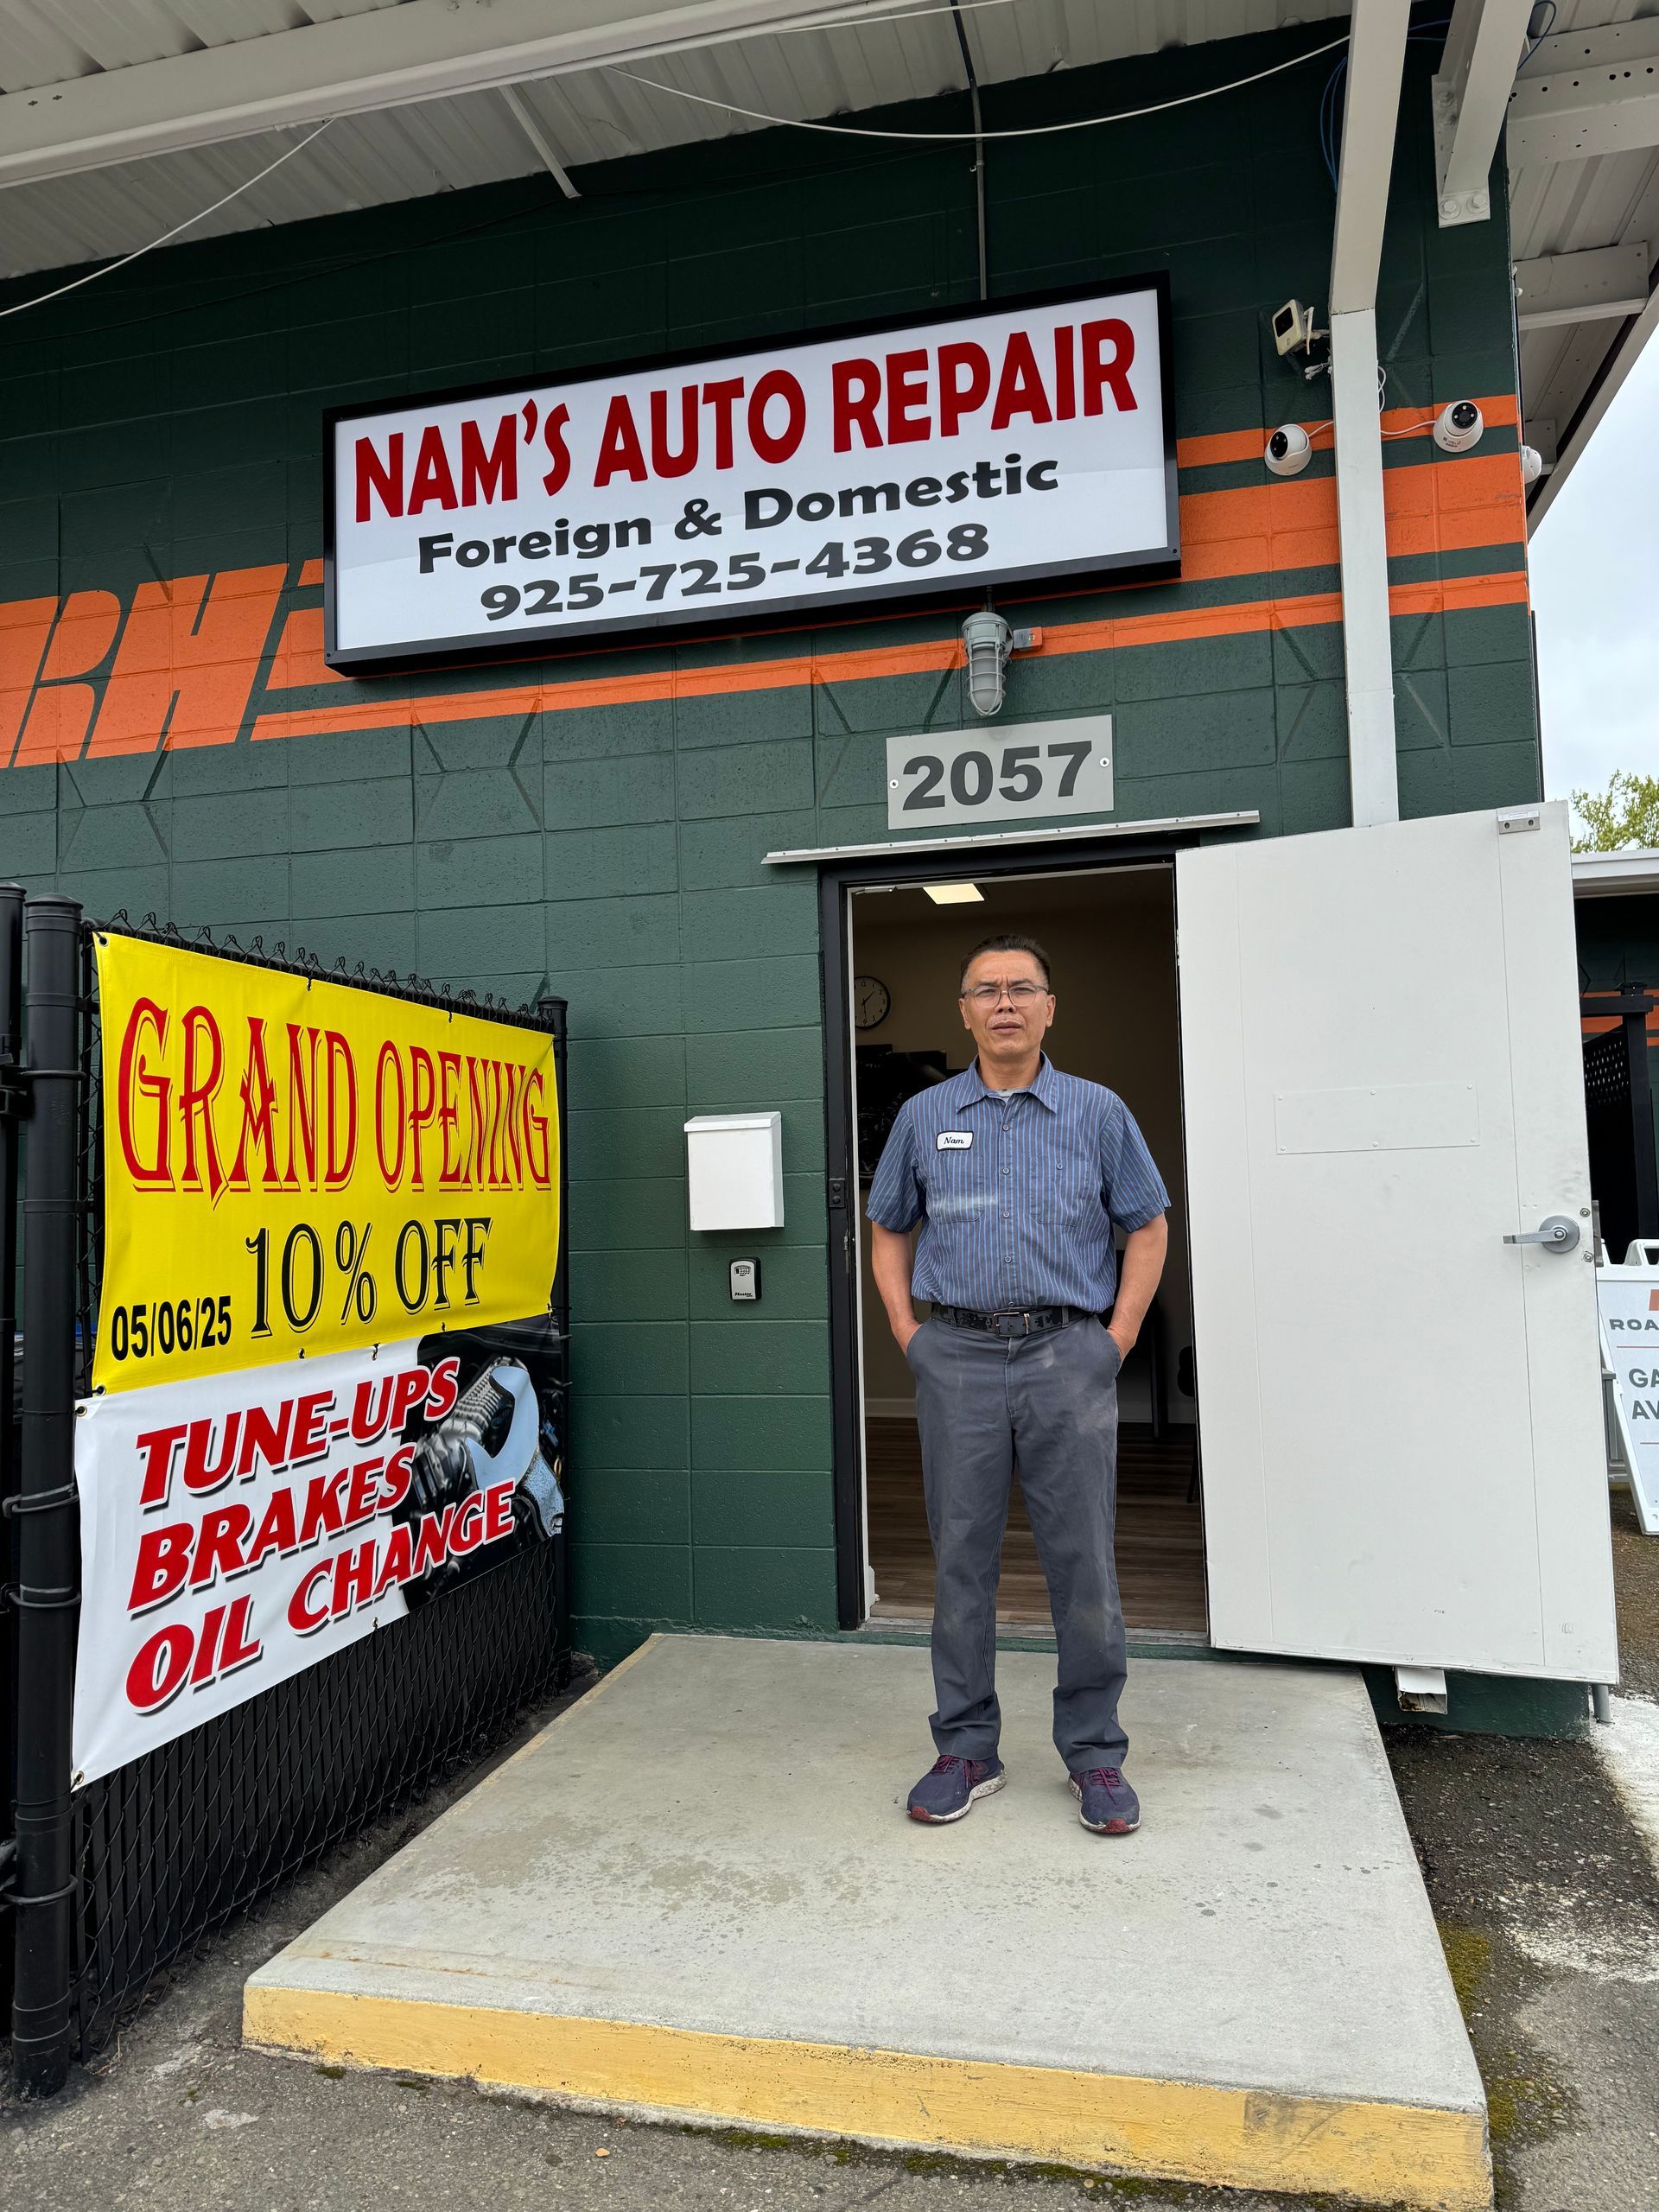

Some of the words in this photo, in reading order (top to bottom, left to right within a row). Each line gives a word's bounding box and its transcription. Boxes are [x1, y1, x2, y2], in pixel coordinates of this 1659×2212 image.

[355, 398, 571, 524] NAM'S
[594, 369, 806, 488] AUTO
[832, 318, 1138, 453] REPAIR
[418, 518, 652, 575] Foreign
[674, 498, 722, 540] &
[744, 453, 1059, 531] Domestic
[480, 523, 989, 621] 925-725-4368
[902, 740, 1092, 811] 2057
[118, 997, 359, 1210] GRAND
[375, 1039, 552, 1193] OPENING
[944, 1136, 965, 1145] Nam
[111, 1295, 232, 1362] 05/06/25
[245, 1220, 377, 1339] 10%
[394, 1217, 493, 1316] OFF
[136, 1357, 461, 1507] TUNE-UPS
[127, 1444, 416, 1611] BRAKES
[124, 1595, 261, 1710] OIL
[287, 1480, 516, 1633] CHANGE
